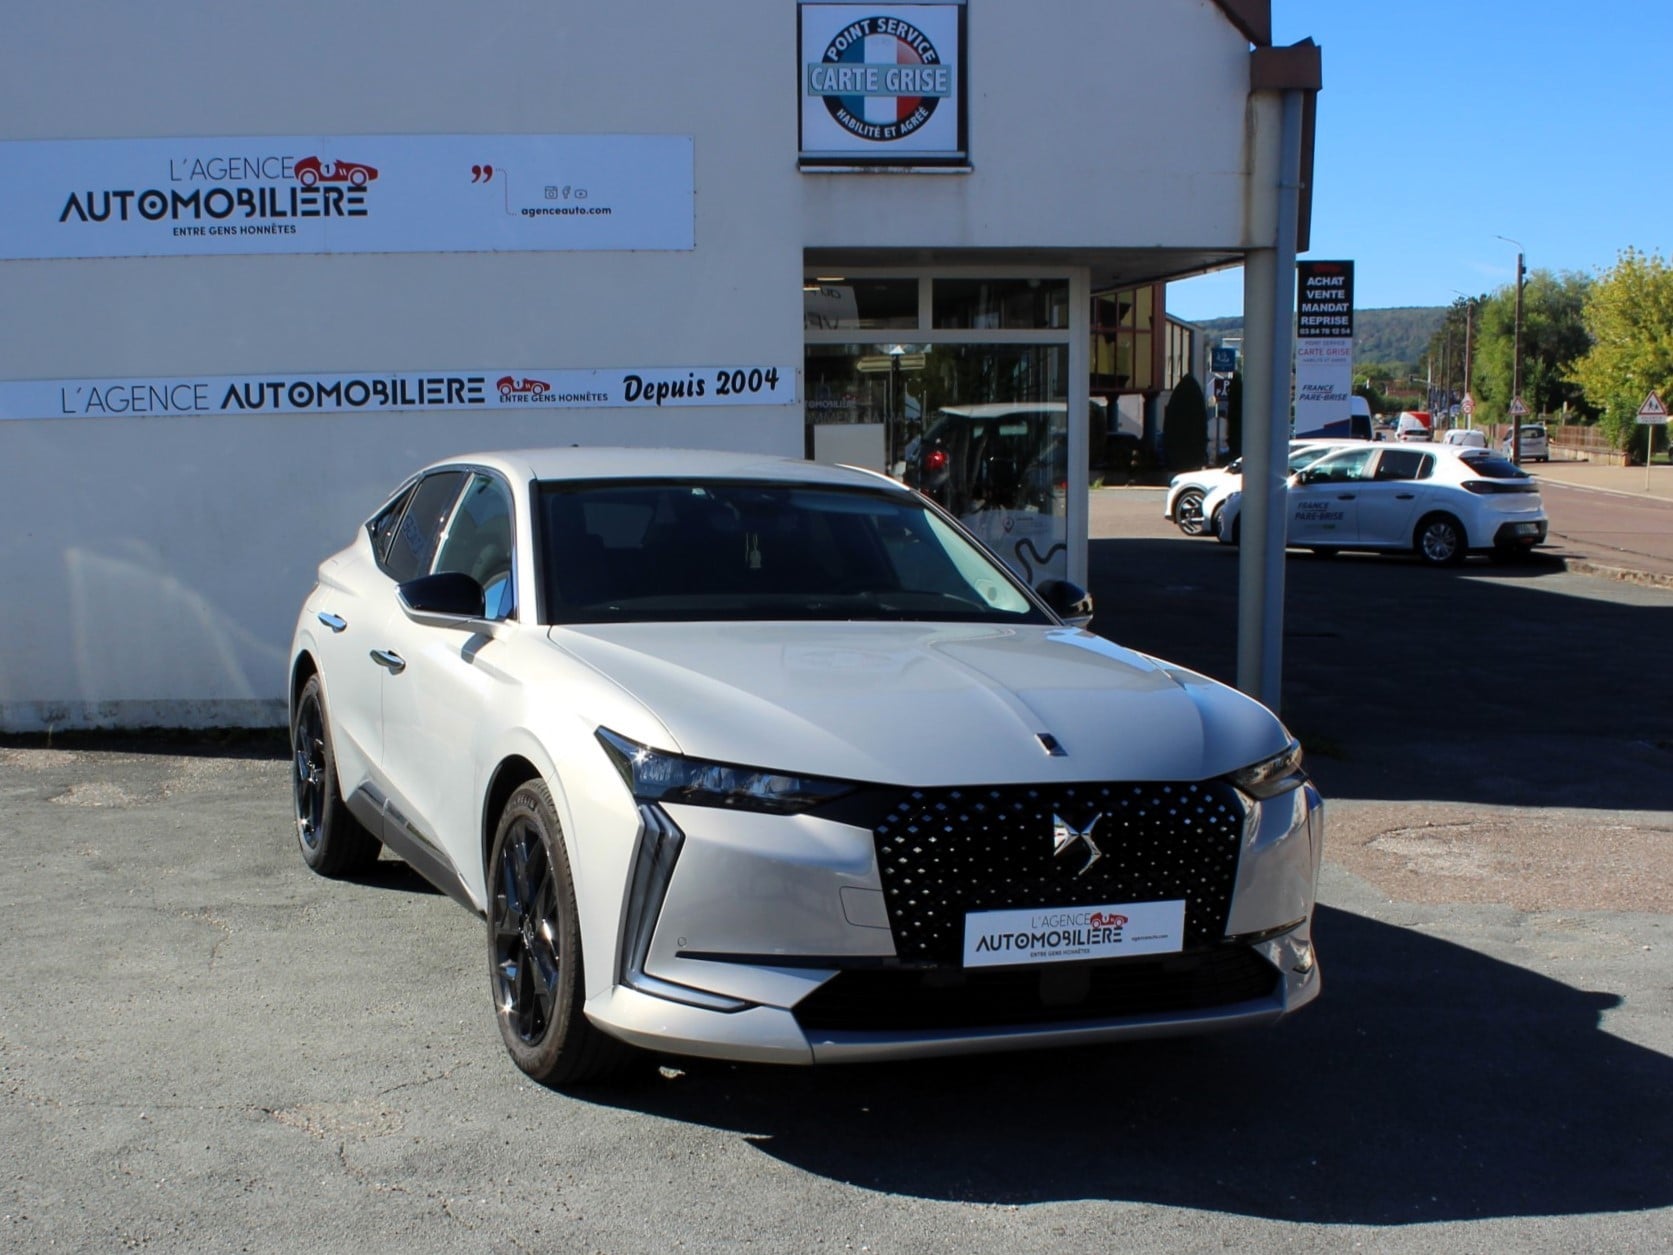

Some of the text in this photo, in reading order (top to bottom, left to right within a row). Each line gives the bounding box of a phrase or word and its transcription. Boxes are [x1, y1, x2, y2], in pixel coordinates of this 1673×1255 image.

[826, 18, 936, 64] POINT SERVICE
[811, 67, 948, 92] CARTE GRISE
[836, 107, 881, 138] HABILITÉ
[884, 128, 897, 138] ET
[170, 156, 294, 182] L'AGENCE
[521, 205, 612, 218] agenceauto.com
[173, 222, 297, 237] ENTRE GENS HONNÊTES
[1307, 276, 1345, 286] ACHAT
[1306, 289, 1345, 299] VENTE
[1301, 303, 1349, 312] MANDAT
[1300, 316, 1349, 325] REPRISE
[624, 366, 780, 406] Depuis 2004
[61, 377, 486, 414] L'AGENCE AUTOMOBILIERE
[500, 391, 608, 403] ENTRE GENS HONNÊTES
[1031, 912, 1091, 929] L'AGENCE
